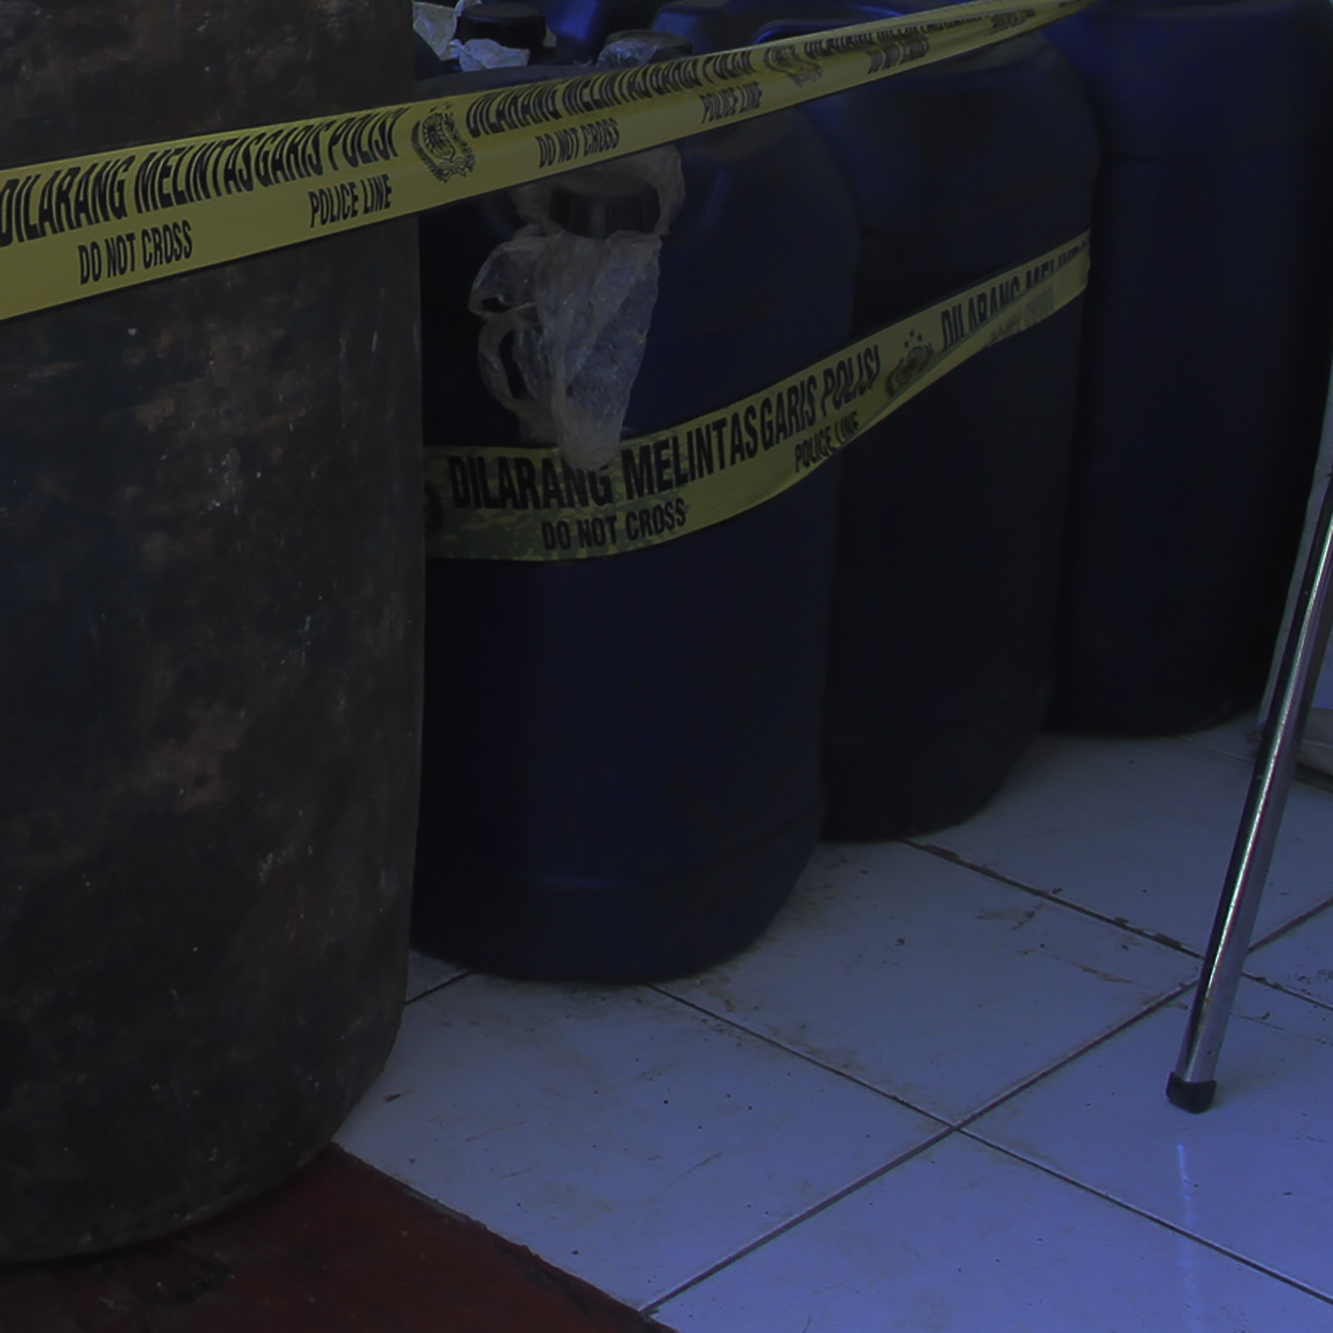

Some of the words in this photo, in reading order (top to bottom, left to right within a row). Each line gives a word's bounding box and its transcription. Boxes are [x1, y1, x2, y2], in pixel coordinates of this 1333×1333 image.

[699, 86, 739, 124] POLICE
[326, 105, 413, 171] POLISI
[535, 133, 557, 168] DO
[555, 127, 580, 165] NOT
[582, 117, 621, 157] CROSS
[308, 182, 359, 229] POLICE
[361, 174, 393, 215] LINE
[77, 242, 103, 286] DO
[104, 233, 137, 278] NOT
[141, 219, 193, 267] CROSS
[821, 345, 882, 417] POLISI
[794, 425, 837, 473] POLICE
[541, 520, 572, 550] DO
[578, 515, 619, 548] NOT
[626, 498, 687, 541] CROSS
